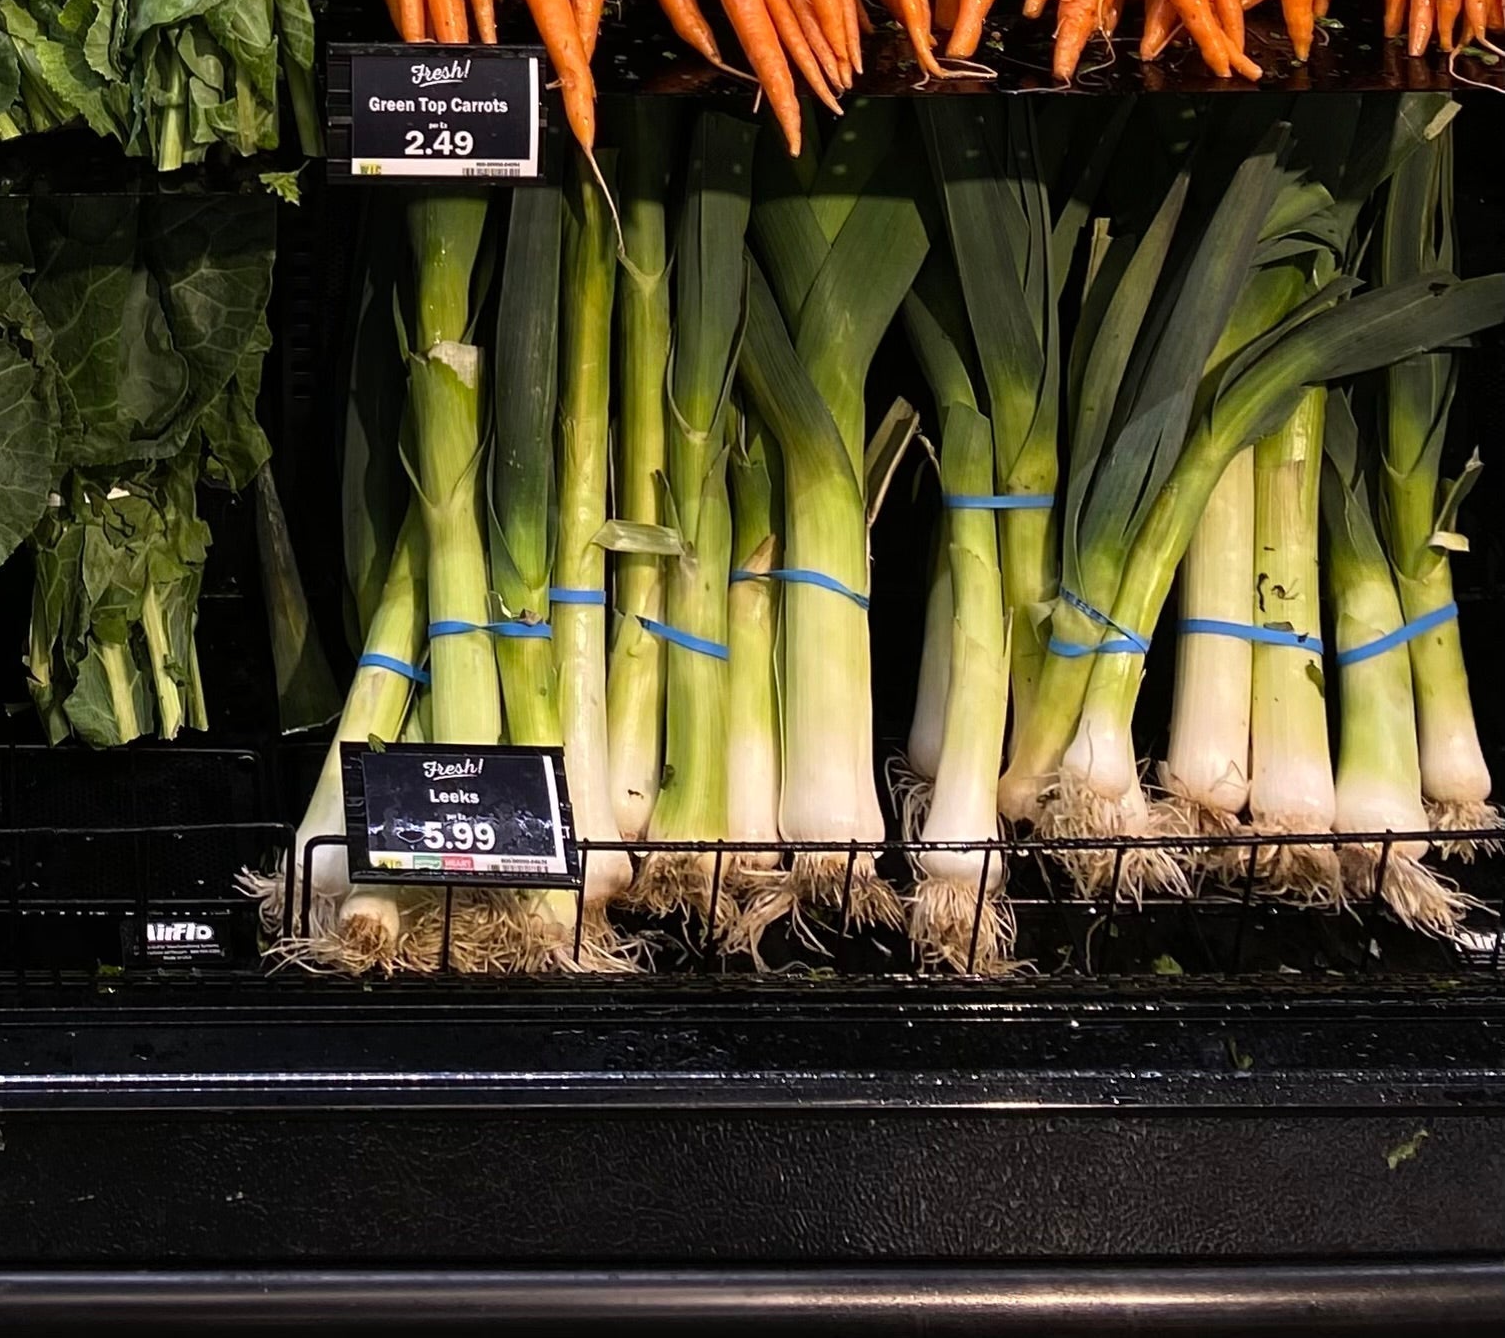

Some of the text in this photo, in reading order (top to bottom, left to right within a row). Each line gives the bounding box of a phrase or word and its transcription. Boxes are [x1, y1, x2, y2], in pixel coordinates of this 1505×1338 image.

[411, 60, 471, 84] Fresh!
[369, 97, 508, 114] Green Top Carrots
[405, 131, 474, 155] 2.49
[423, 758, 484, 779] Fresh!
[430, 789, 479, 804] Leeks
[424, 821, 496, 851] 5.99
